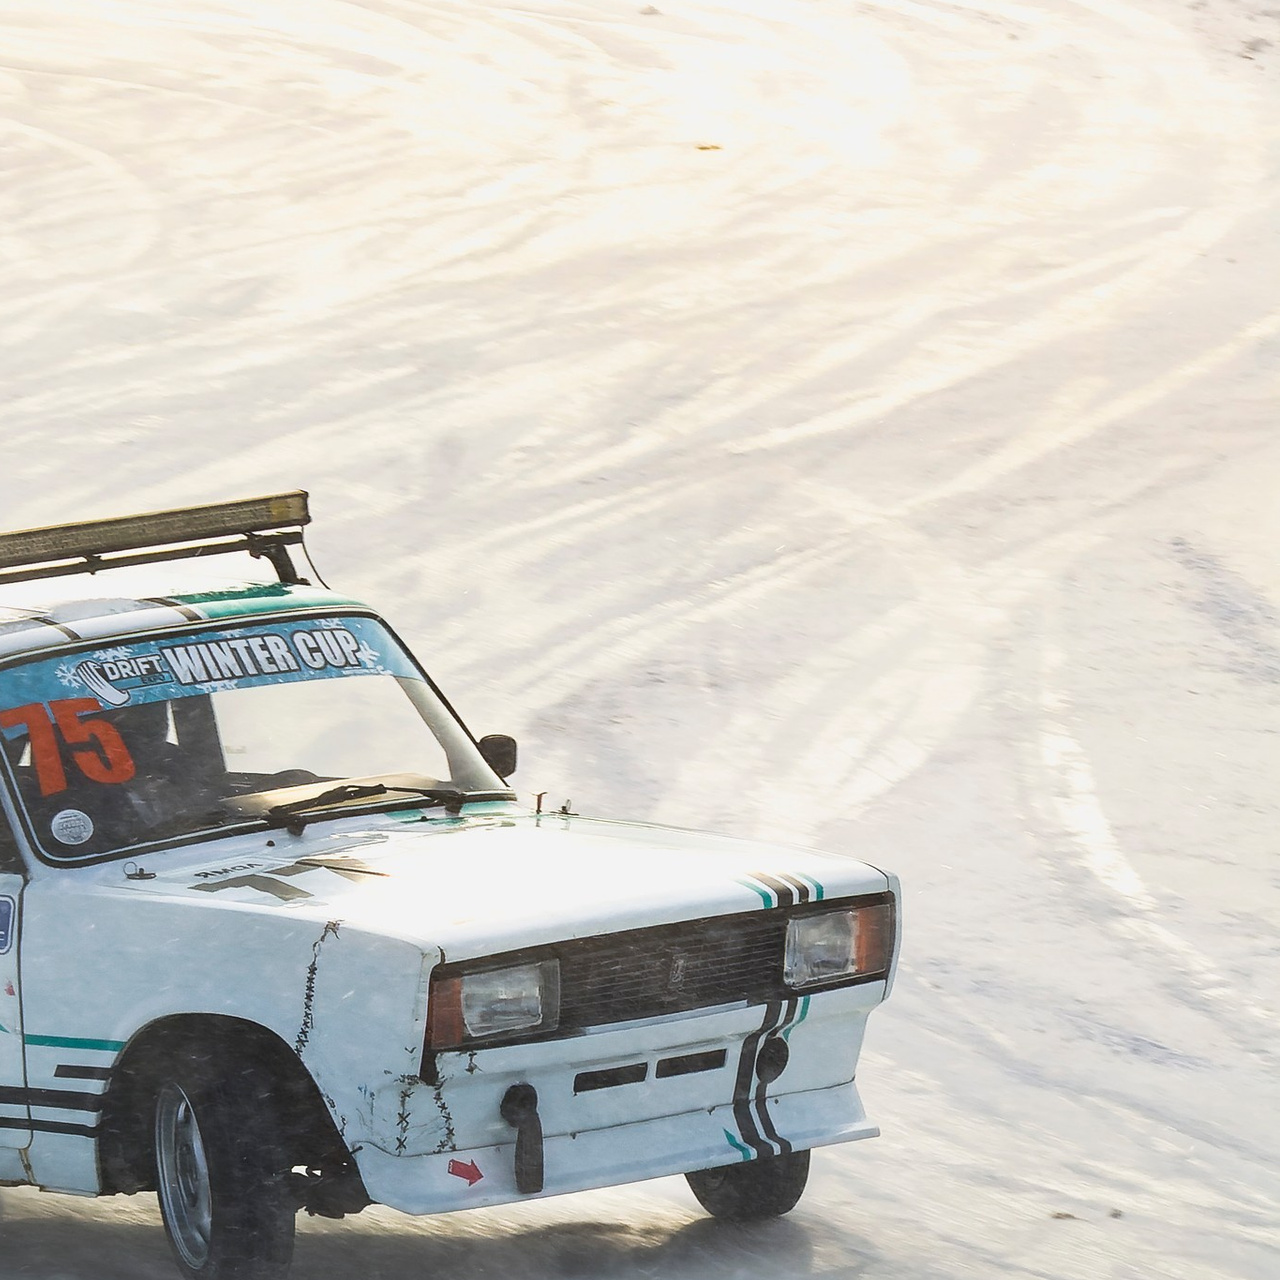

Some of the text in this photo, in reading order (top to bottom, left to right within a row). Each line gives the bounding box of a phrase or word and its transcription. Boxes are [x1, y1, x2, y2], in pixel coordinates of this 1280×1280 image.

[102, 628, 362, 685] DRIFT WINTER CUP
